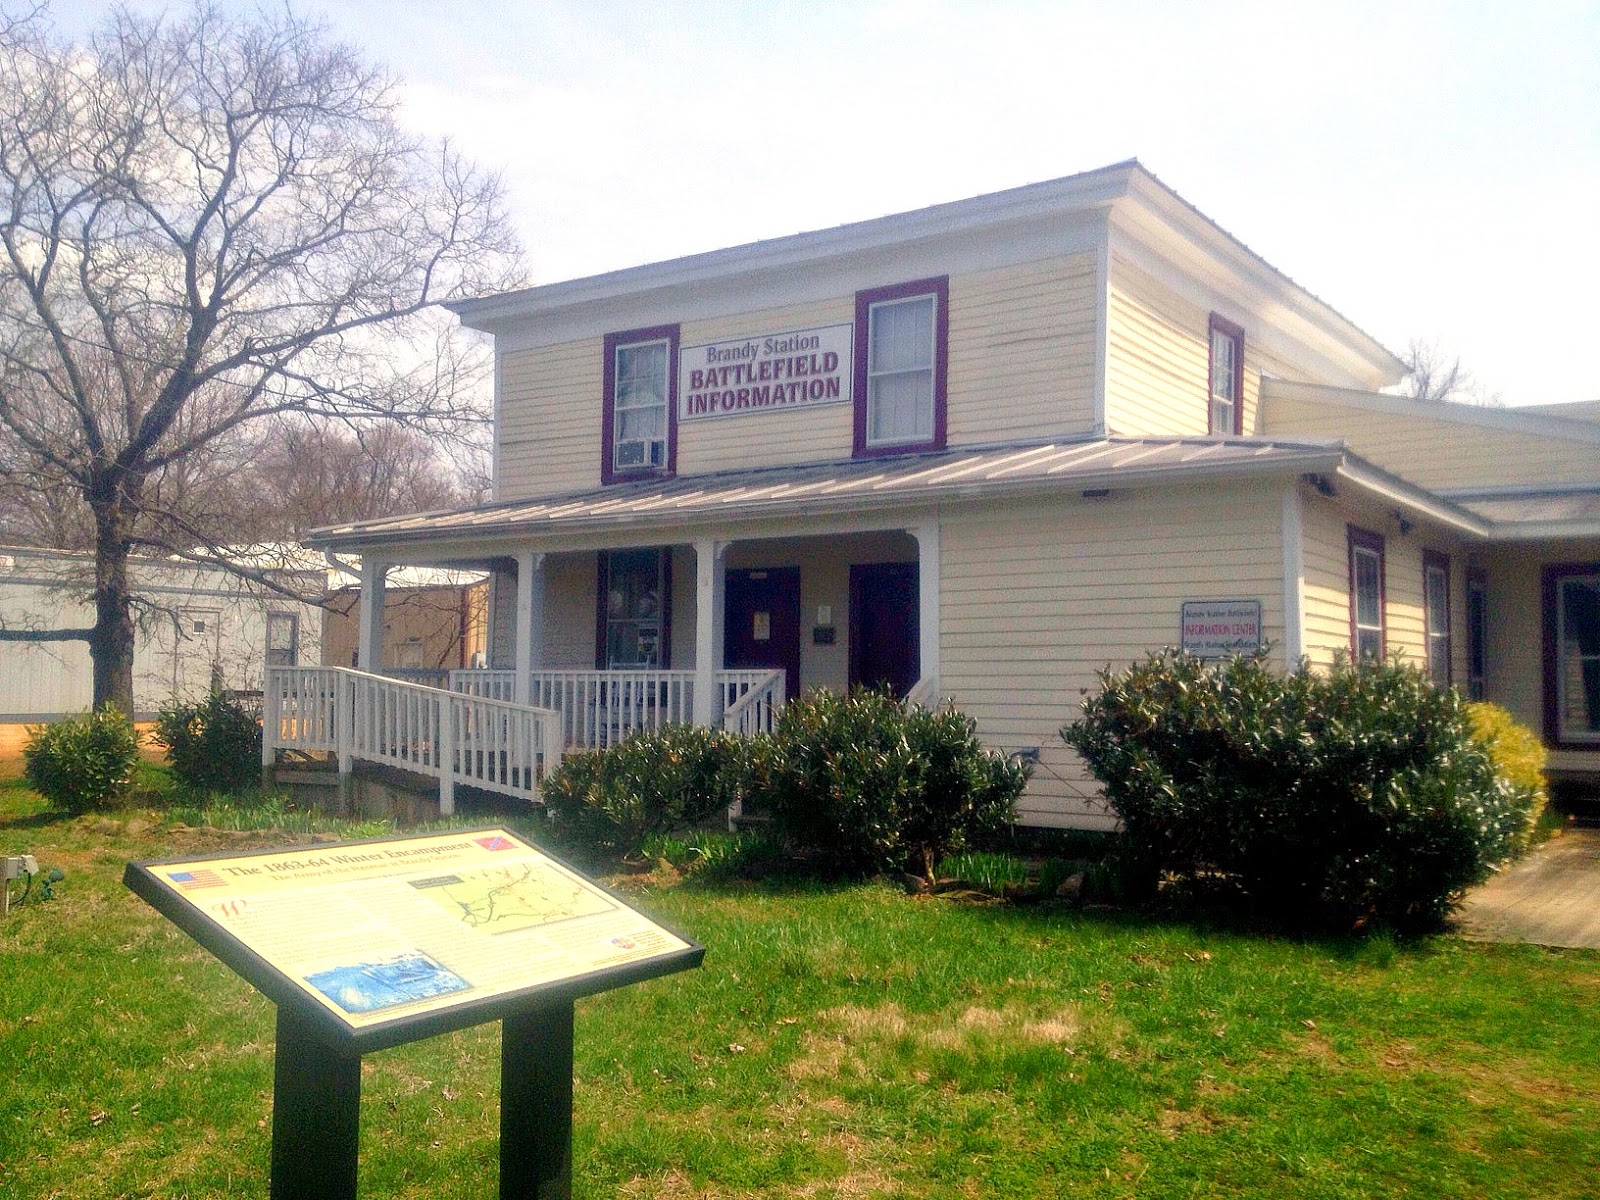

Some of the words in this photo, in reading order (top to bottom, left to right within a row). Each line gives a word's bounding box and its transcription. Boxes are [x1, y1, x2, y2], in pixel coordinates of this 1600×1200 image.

[706, 341, 760, 364] Brandy
[763, 335, 820, 355] Station
[691, 351, 839, 390] BATTLEFIELD
[688, 376, 840, 415] INFORMATION
[1185, 623, 1230, 636] INFORMATION
[1232, 622, 1256, 636] CENTER
[221, 866, 263, 877] The
[263, 857, 331, 873] 1863-64
[328, 853, 384, 864] Winter
[383, 841, 475, 858] Encampment
